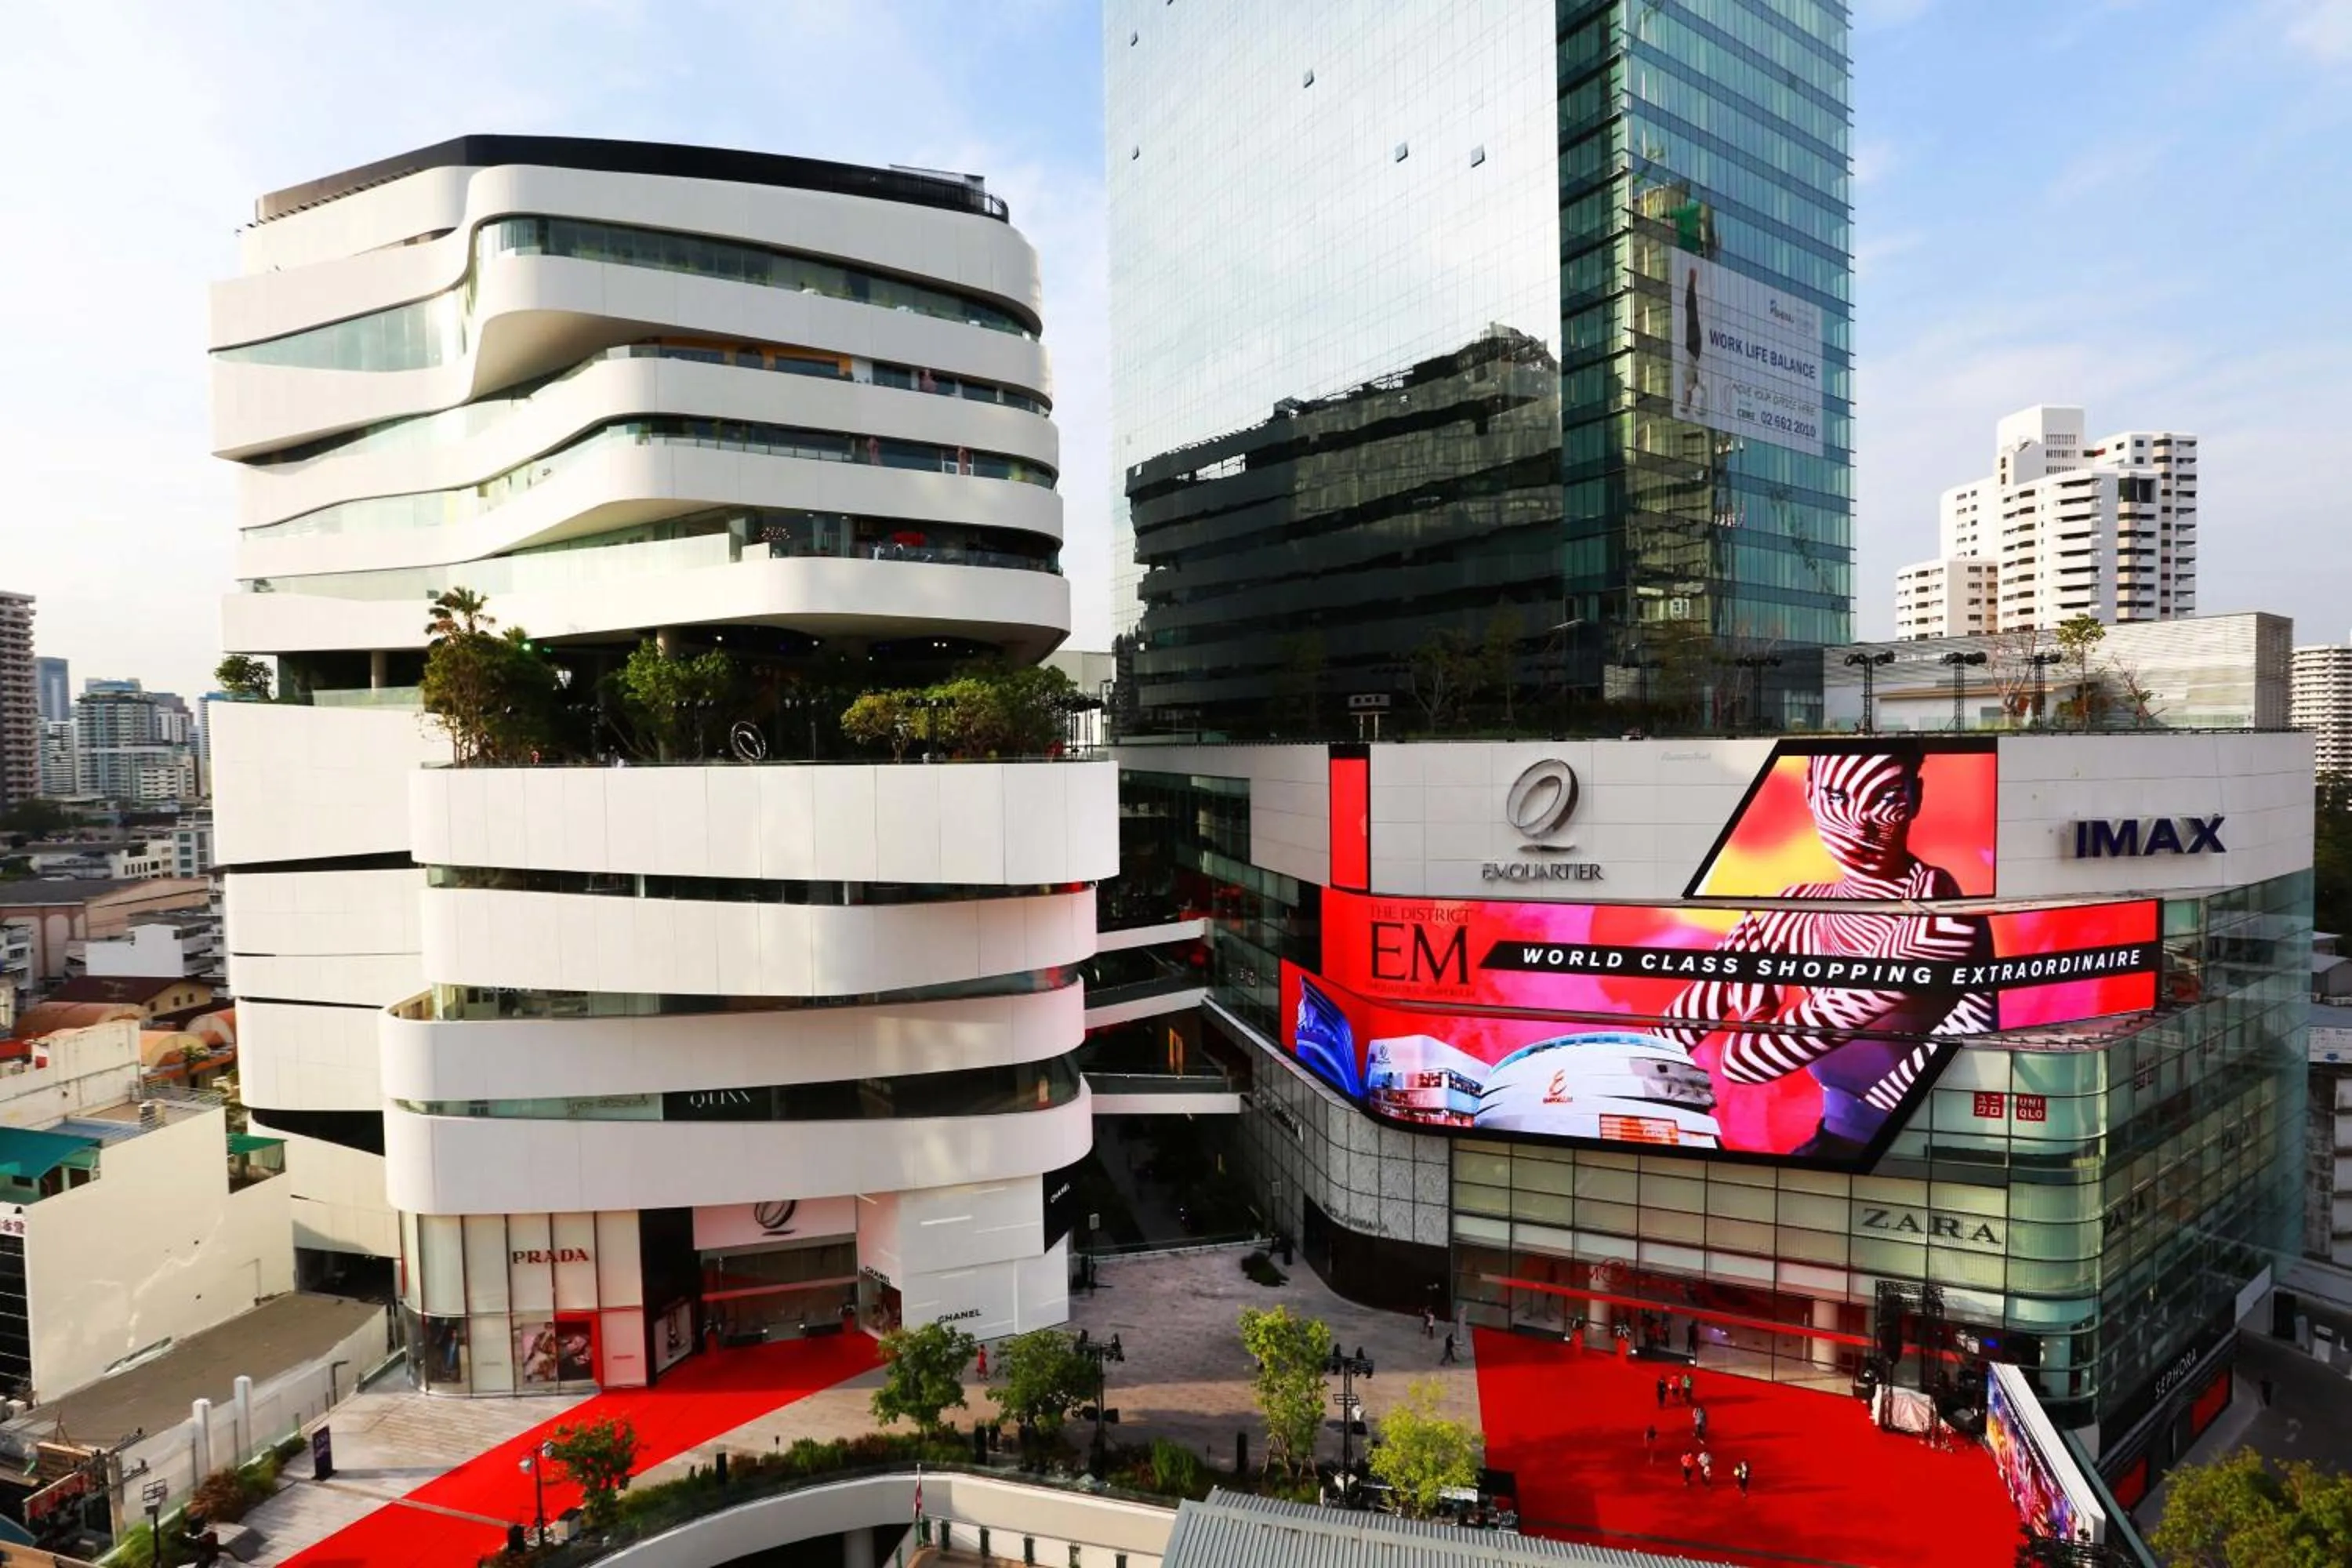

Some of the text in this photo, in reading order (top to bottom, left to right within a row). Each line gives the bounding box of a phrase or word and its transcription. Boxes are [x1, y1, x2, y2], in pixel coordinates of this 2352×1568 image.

[1709, 328, 1816, 379] WORK LIFE BALANCE
[2074, 815, 2227, 859] IMAX
[1481, 862, 1605, 881] EMQUARTIER
[1400, 906, 1472, 924] DISTRICT
[1370, 921, 1470, 985] EM
[1523, 947, 2141, 985] WORLD CLASS SHOPPING EXTRAORDINAIRE
[2019, 1098, 2042, 1108] UNI
[2019, 1108, 2042, 1119] QLO
[1862, 1207, 2002, 1244] ZARA
[512, 1247, 590, 1265] PRADA
[865, 1265, 892, 1286] CHANEL
[937, 1308, 982, 1325] CHANEL
[2154, 1347, 2197, 1401] SEPHORA
